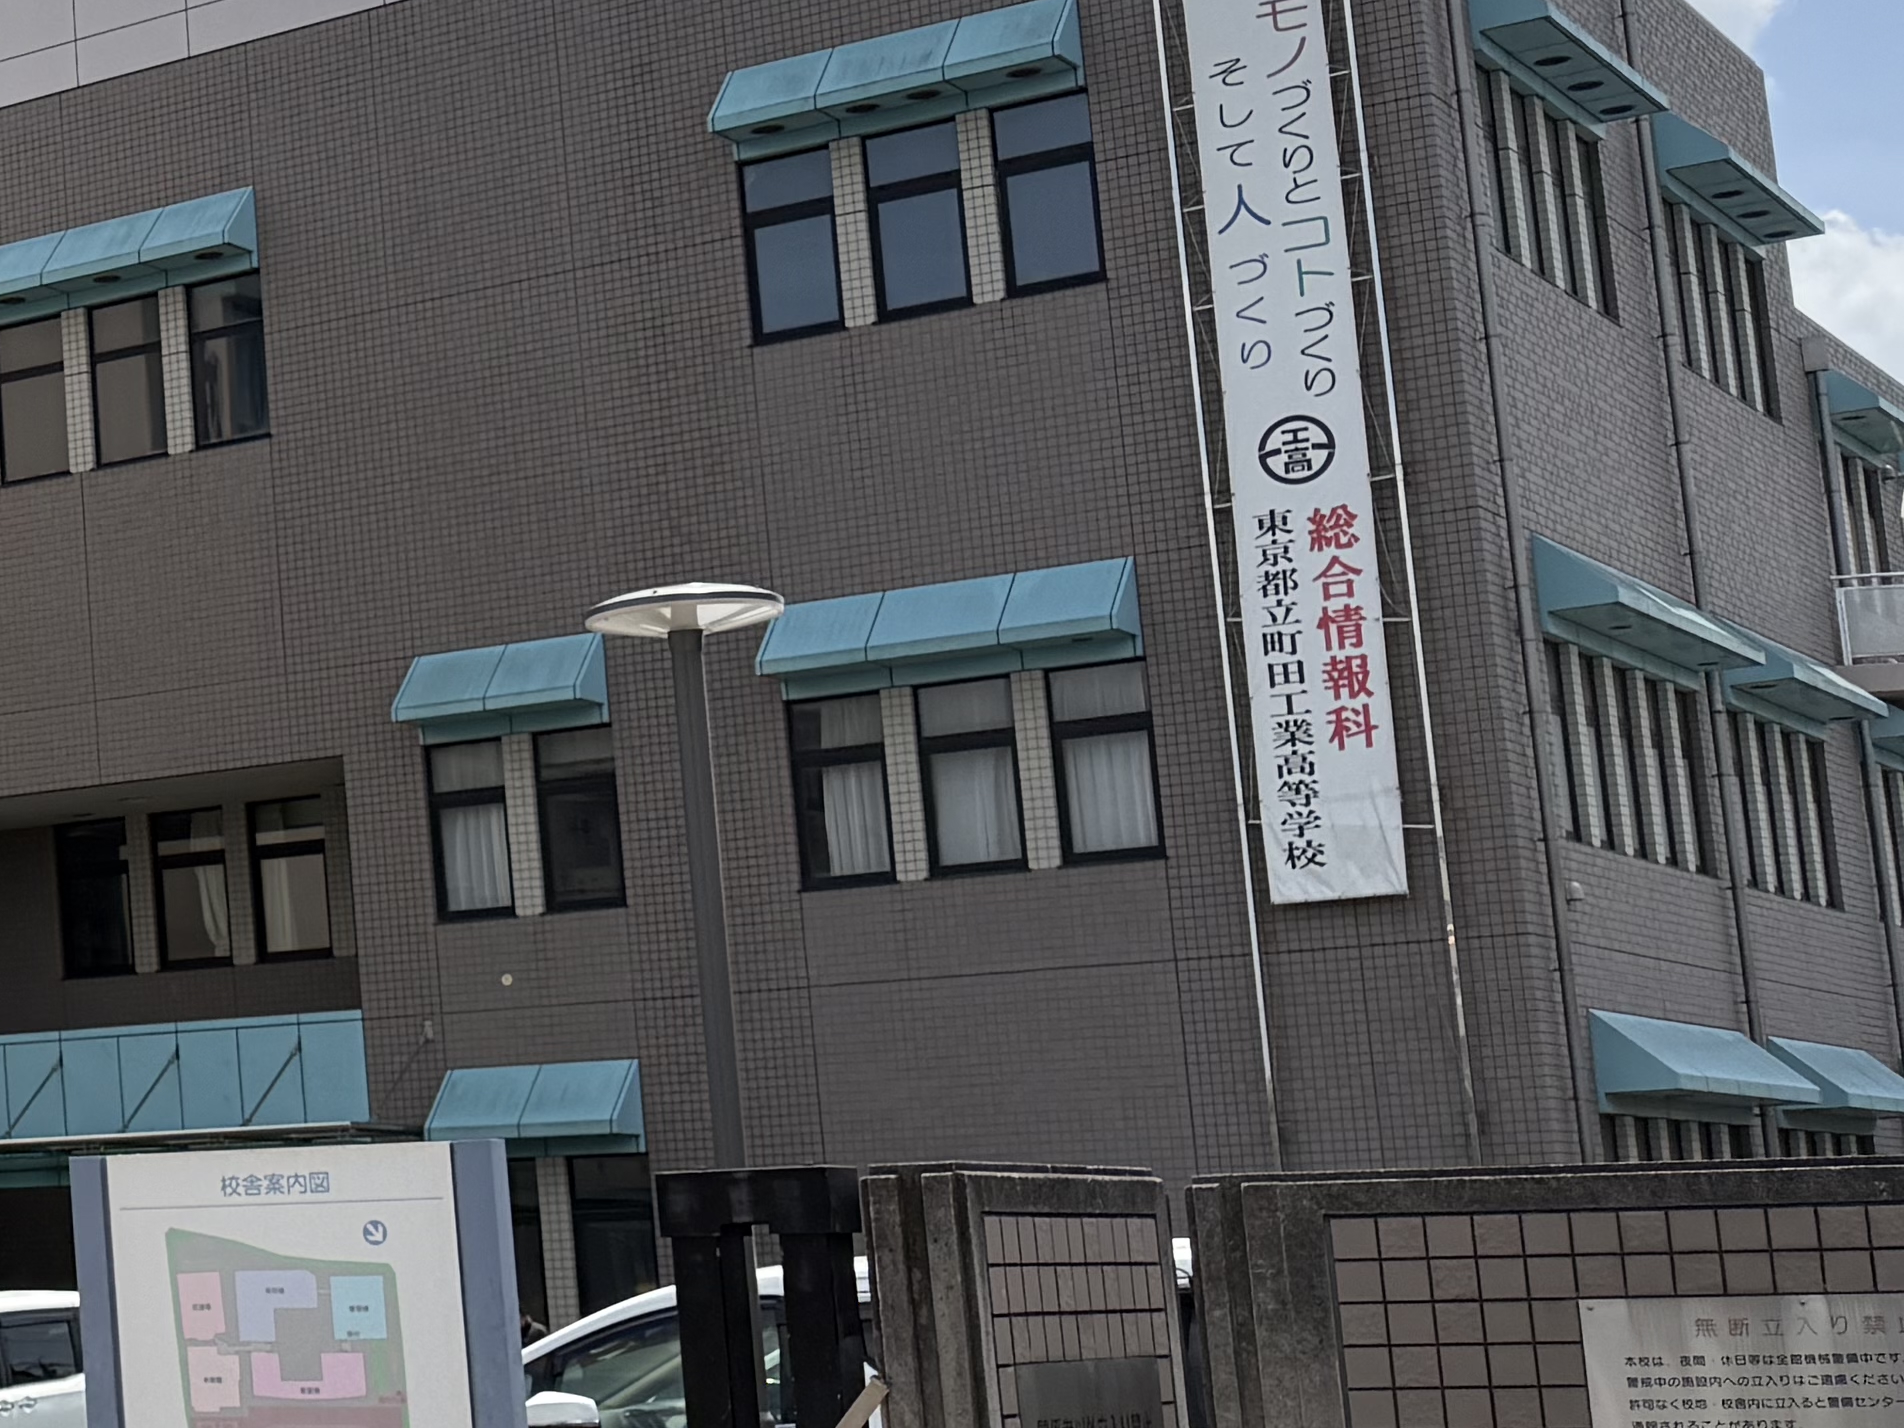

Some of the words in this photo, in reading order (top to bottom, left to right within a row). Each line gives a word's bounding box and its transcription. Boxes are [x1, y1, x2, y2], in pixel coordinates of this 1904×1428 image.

[1208, 57, 1272, 370] そして人づくり
[1252, 508, 1328, 871] 東京都立町田工業高等学校
[1306, 502, 1380, 752] 総合情報科
[220, 1172, 330, 1197] 校舎案内図
